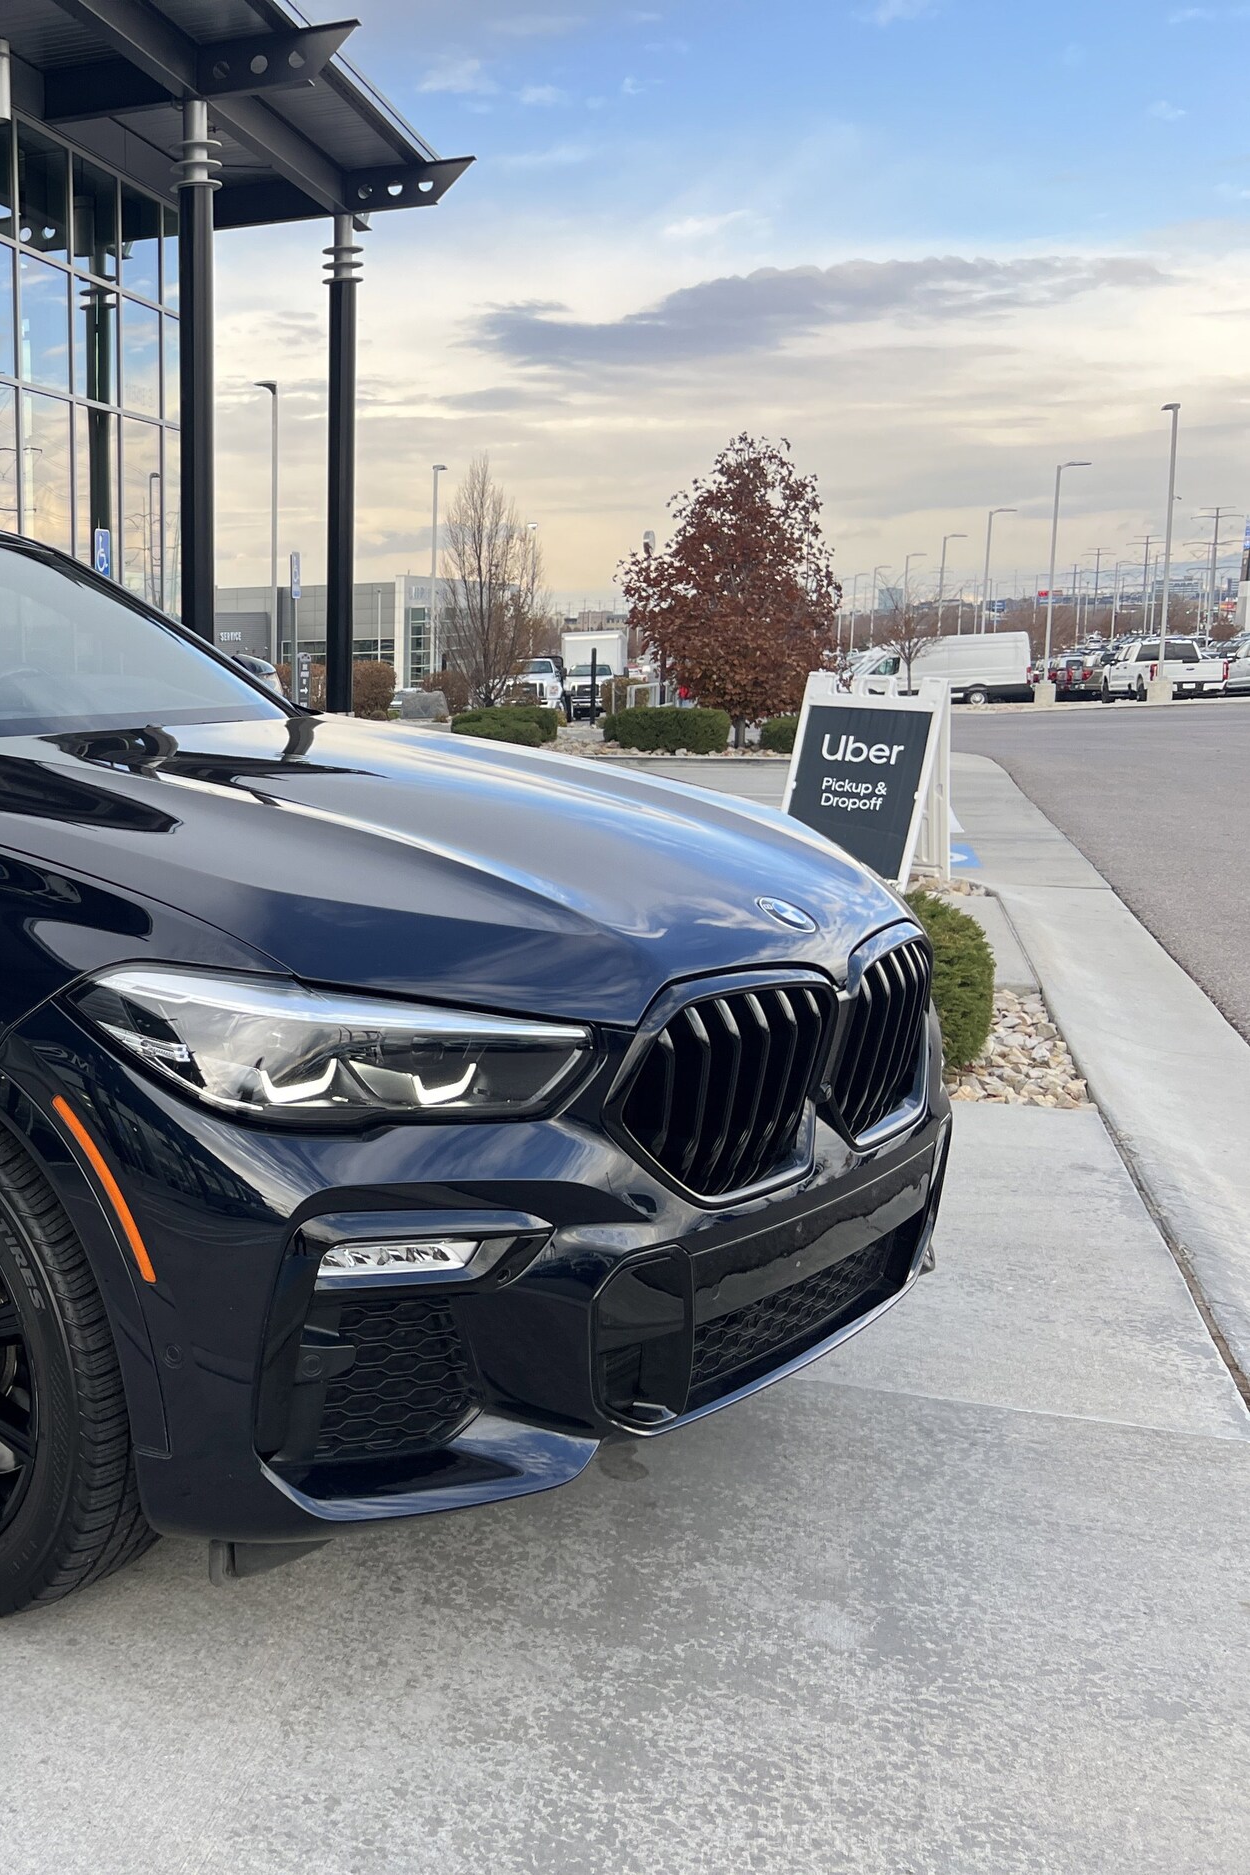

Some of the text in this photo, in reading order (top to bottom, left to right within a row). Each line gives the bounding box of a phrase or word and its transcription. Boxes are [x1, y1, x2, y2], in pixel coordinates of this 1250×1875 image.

[821, 734, 904, 765] Uber
[821, 777, 887, 796] Pickup &
[821, 793, 883, 811] Dropoff
